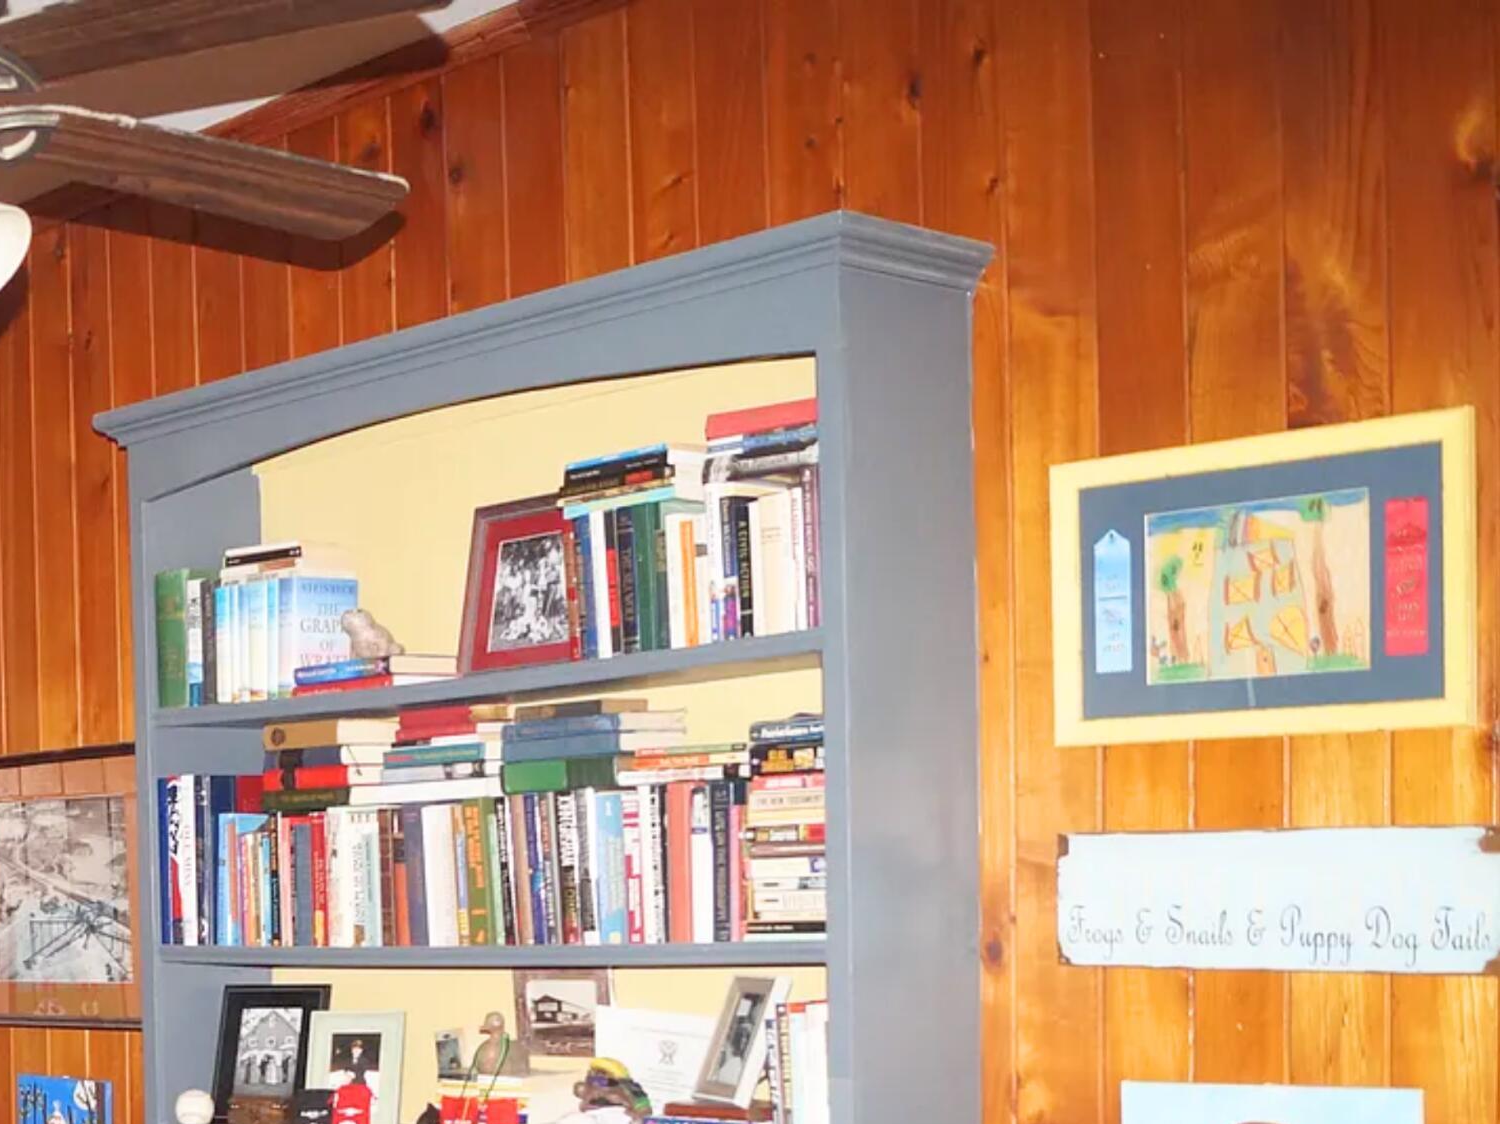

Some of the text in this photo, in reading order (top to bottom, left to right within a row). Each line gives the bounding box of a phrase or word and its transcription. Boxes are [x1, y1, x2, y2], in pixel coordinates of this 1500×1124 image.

[738, 530, 748, 559] CIVIL
[740, 562, 751, 598] ACTION
[302, 583, 354, 595] STEINBECK
[317, 603, 339, 616] THE
[300, 617, 343, 633] GRAP
[320, 639, 334, 651] OF
[1066, 905, 1494, 965] Frogs & Snails & Puppy Dog Tails
